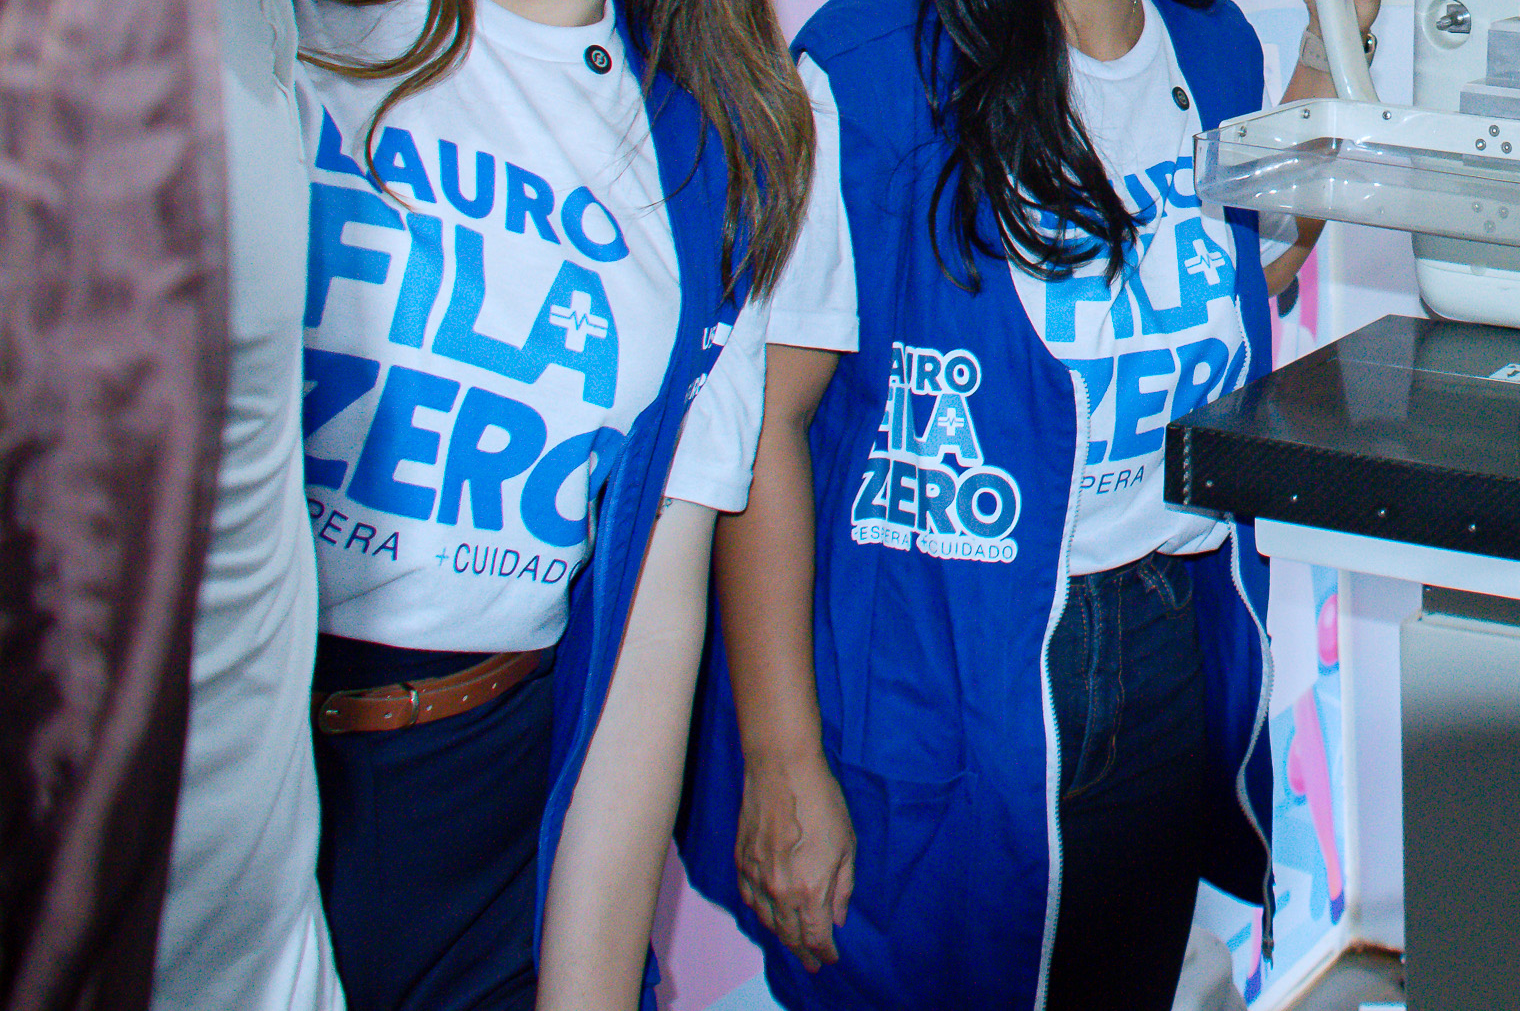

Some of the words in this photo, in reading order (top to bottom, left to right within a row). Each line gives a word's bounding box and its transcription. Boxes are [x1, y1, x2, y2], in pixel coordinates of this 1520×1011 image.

[315, 105, 630, 262] LAURO
[304, 181, 620, 409] FILA
[303, 347, 628, 547] ZERO
[852, 457, 1022, 541] ZERO
